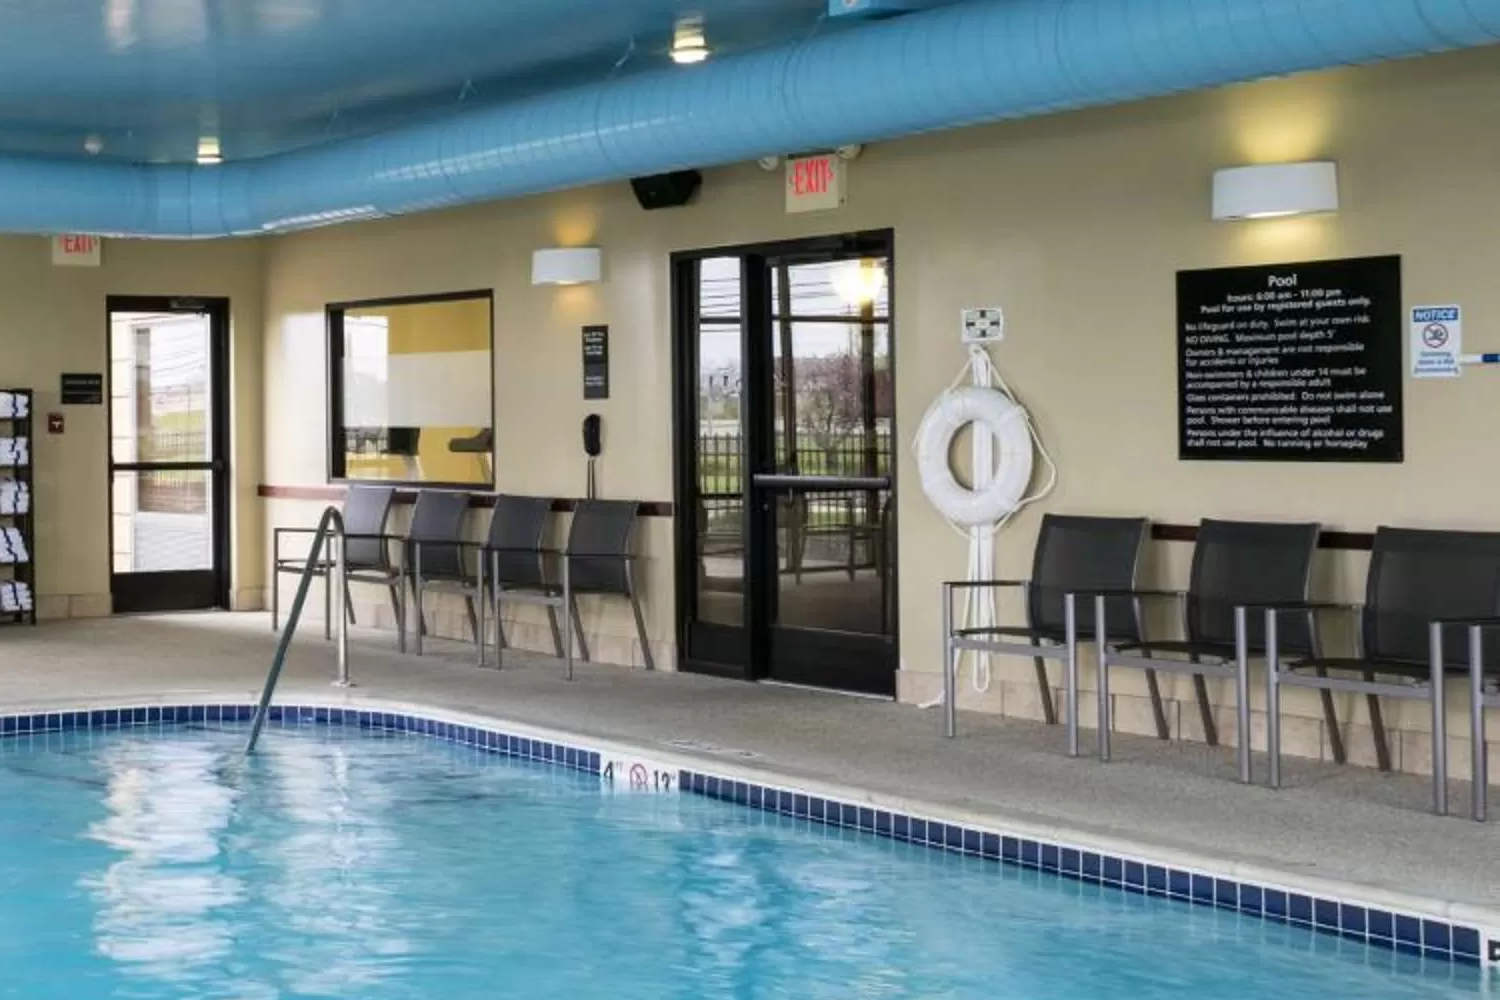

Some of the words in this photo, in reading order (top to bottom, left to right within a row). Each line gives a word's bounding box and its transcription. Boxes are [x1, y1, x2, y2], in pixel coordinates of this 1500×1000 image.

[795, 158, 828, 195] EXIT
[1267, 273, 1297, 287] Pool
[1326, 288, 1342, 299] pm
[1200, 305, 1220, 314] Pool
[1221, 303, 1235, 313] for
[1236, 304, 1252, 313] use
[1253, 303, 1265, 313] by
[1267, 301, 1313, 312] registered
[1315, 299, 1346, 311] guests
[1415, 309, 1456, 321] NOTICE
[1185, 323, 1197, 331] No
[1198, 321, 1235, 333] lifeguard
[1235, 322, 1248, 330] on
[1273, 317, 1296, 328] Swim
[1309, 317, 1329, 328] your
[1331, 317, 1351, 326] own
[1185, 335, 1198, 344] NO
[1235, 333, 1276, 343] Maximum
[1277, 331, 1297, 342] pool
[1299, 330, 1325, 341] depth
[1185, 347, 1216, 357] Owners
[1225, 345, 1279, 358] management
[1281, 345, 1296, 355] are
[1297, 344, 1313, 353] not
[1315, 341, 1365, 355] responsible
[1185, 358, 1198, 367] for
[1199, 357, 1236, 367] accidents
[1237, 357, 1246, 365] or
[1247, 356, 1279, 367] injuries
[1254, 367, 1289, 378] children
[1290, 367, 1316, 377] under
[1330, 366, 1352, 376] must
[1353, 365, 1367, 376] be
[1185, 380, 1238, 391] accompanied
[1240, 380, 1250, 391] by
[1259, 379, 1306, 390] responsible
[1185, 393, 1206, 402] Glass
[1207, 392, 1249, 402] containers
[1301, 391, 1315, 400] Do
[1316, 390, 1332, 400] not
[1333, 391, 1357, 400] swim
[1185, 406, 1217, 415] Persons
[1217, 405, 1236, 415] with
[1237, 403, 1298, 415] communicable
[1299, 404, 1335, 414] diseases
[1336, 402, 1357, 413] shall
[1358, 403, 1375, 413] not
[1376, 404, 1393, 413] use
[1210, 415, 1241, 425] Shower
[1242, 415, 1270, 426] before
[1271, 415, 1309, 427] entering
[1186, 429, 1217, 438] Persons
[1218, 428, 1242, 438] under
[1243, 428, 1259, 437] the
[1260, 427, 1299, 438] influence
[1300, 427, 1311, 437] of
[1312, 427, 1344, 438] alcohol
[1345, 429, 1357, 438] or
[1358, 428, 1384, 440] drugs
[1186, 438, 1205, 448] shall
[1206, 438, 1220, 448] not
[1221, 439, 1237, 448] use
[1263, 438, 1276, 448] No
[1277, 439, 1311, 451] running
[1313, 440, 1323, 449] or
